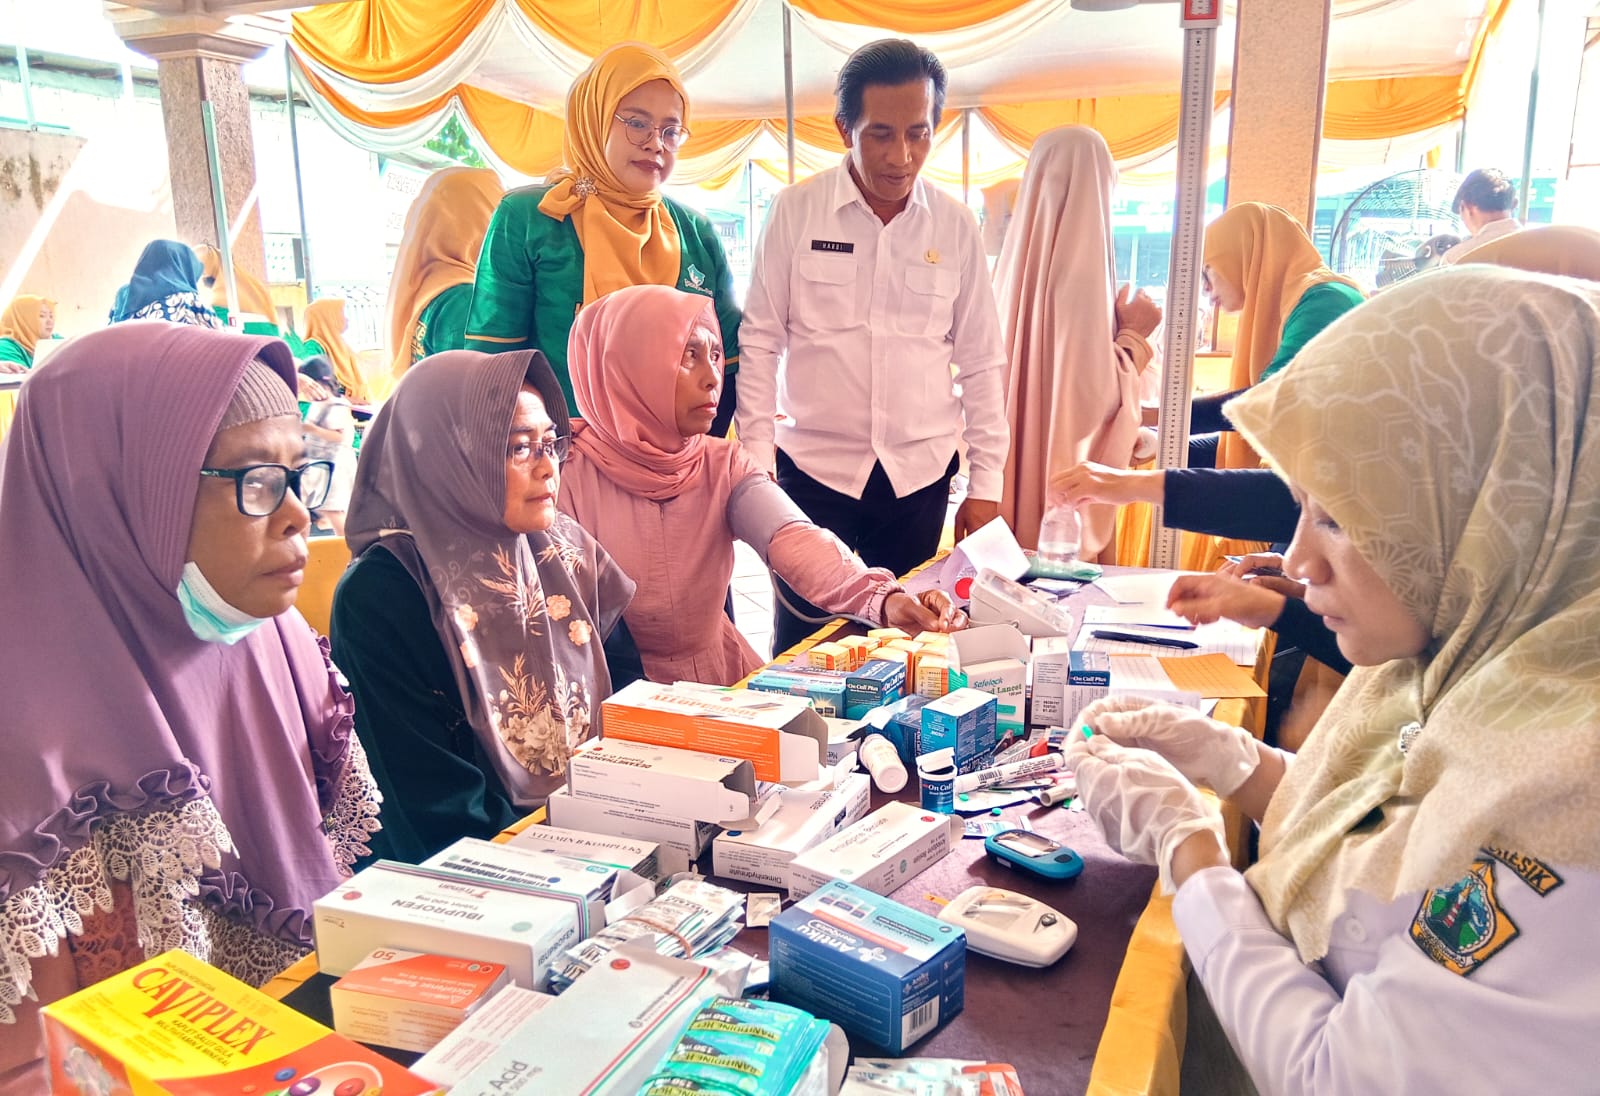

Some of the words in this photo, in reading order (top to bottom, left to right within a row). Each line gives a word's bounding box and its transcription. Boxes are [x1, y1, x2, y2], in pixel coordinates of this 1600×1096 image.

[997, 684, 1022, 694] Lancet
[531, 832, 573, 843] VITAMIN
[584, 840, 642, 855] KOMPLEKS
[391, 898, 484, 921] IBUPROFEN
[538, 927, 575, 966] IBUPROFEN
[797, 925, 855, 953] Antiku
[372, 949, 396, 961] 50
[132, 968, 275, 1055] CAVIPLEX
[713, 1013, 732, 1022] 150
[695, 1045, 713, 1054] 150
[489, 1060, 529, 1091] Acid
[675, 1079, 692, 1088] 150
